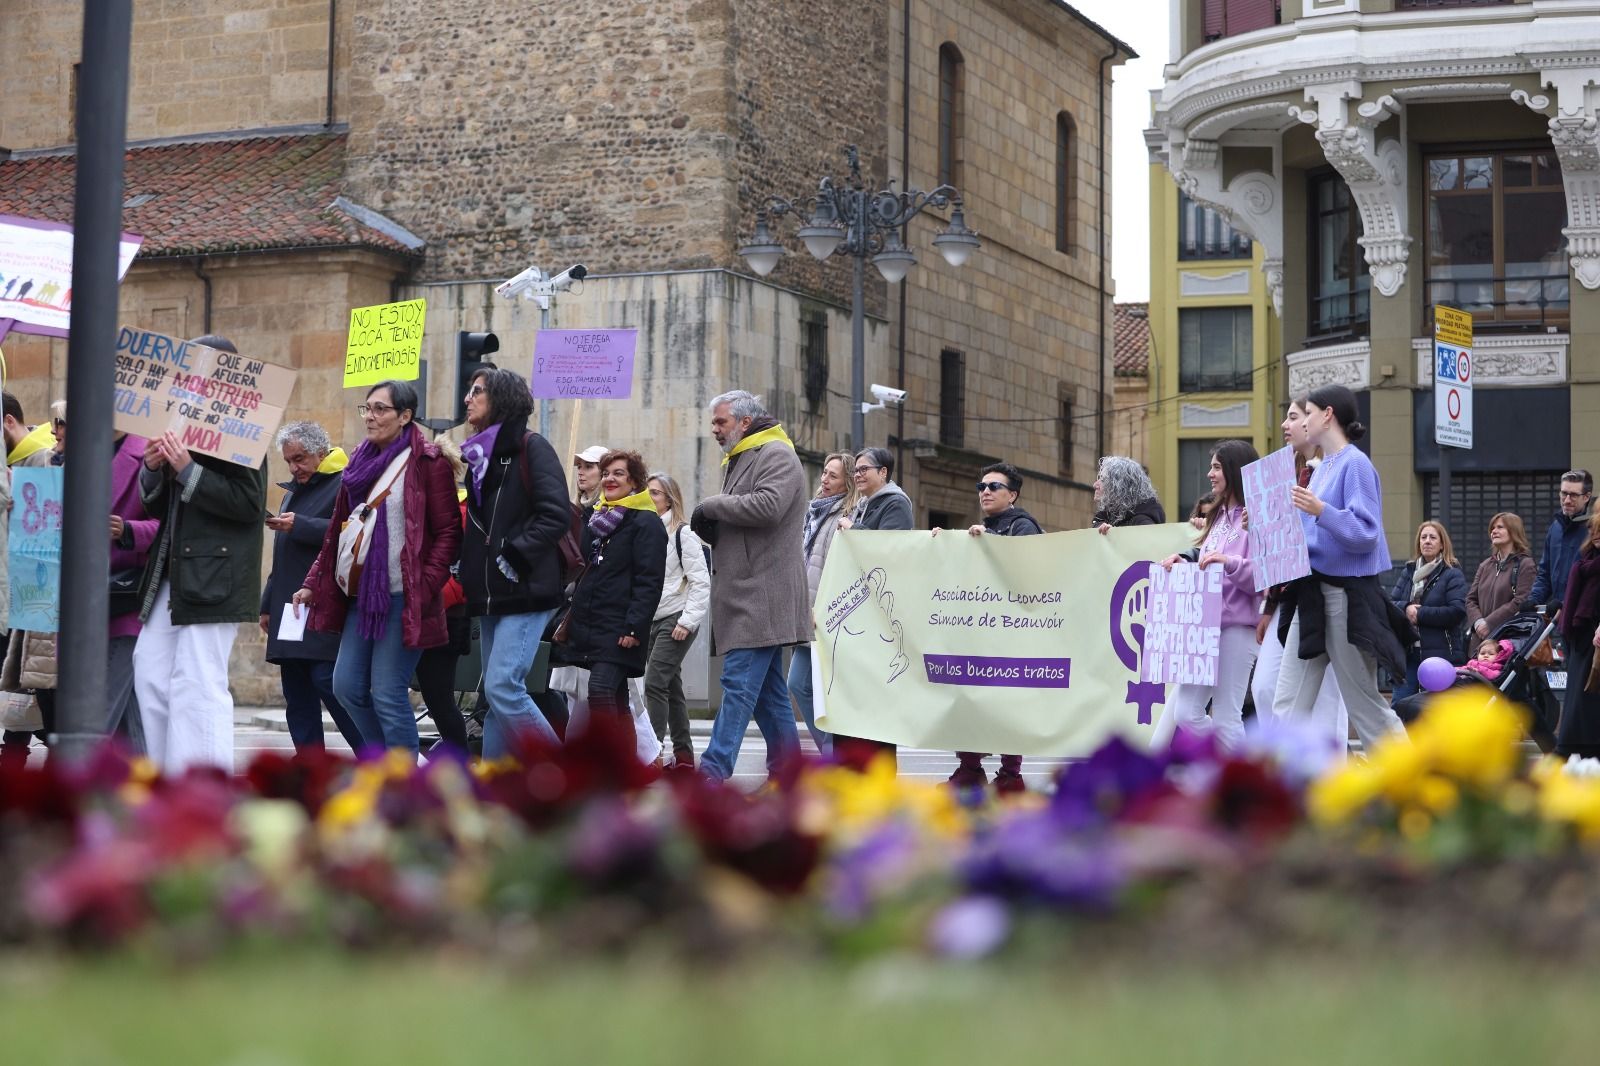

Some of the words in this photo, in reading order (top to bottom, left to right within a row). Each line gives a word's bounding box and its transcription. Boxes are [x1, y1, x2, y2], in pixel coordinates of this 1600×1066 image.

[353, 309, 371, 328] NO
[379, 301, 424, 325] ESTOY
[388, 324, 421, 342] TENGO
[564, 335, 578, 345] NO
[576, 344, 601, 353] PERO
[114, 354, 145, 375] SOLO
[148, 362, 169, 380] HAY
[217, 353, 241, 373] QUE
[1460, 362, 1467, 373] 10
[114, 371, 139, 389] OLO
[141, 377, 164, 392] HAY
[211, 400, 232, 415] QUE
[235, 406, 248, 419] TE
[165, 400, 175, 412] Y
[178, 402, 204, 420] QUE
[204, 413, 220, 425] NO
[219, 416, 264, 442] SIENTE
[182, 424, 223, 453] NADA
[1149, 563, 1166, 593] TU
[1168, 562, 1223, 594] MENTE
[931, 585, 1003, 602] Asociación
[1008, 590, 1062, 604] Leonesa
[825, 602, 852, 628] SIMONE
[850, 593, 862, 604] DE
[928, 610, 974, 627] Simone
[978, 612, 997, 628] de
[1001, 611, 1065, 629] Beauvoir
[1144, 622, 1184, 655] CORTA
[1186, 624, 1221, 657] QUE
[927, 661, 944, 676] Por
[946, 660, 962, 676] los
[967, 660, 1020, 678] buenos
[1023, 664, 1065, 679] tratos
[1168, 653, 1215, 686] FALDA
